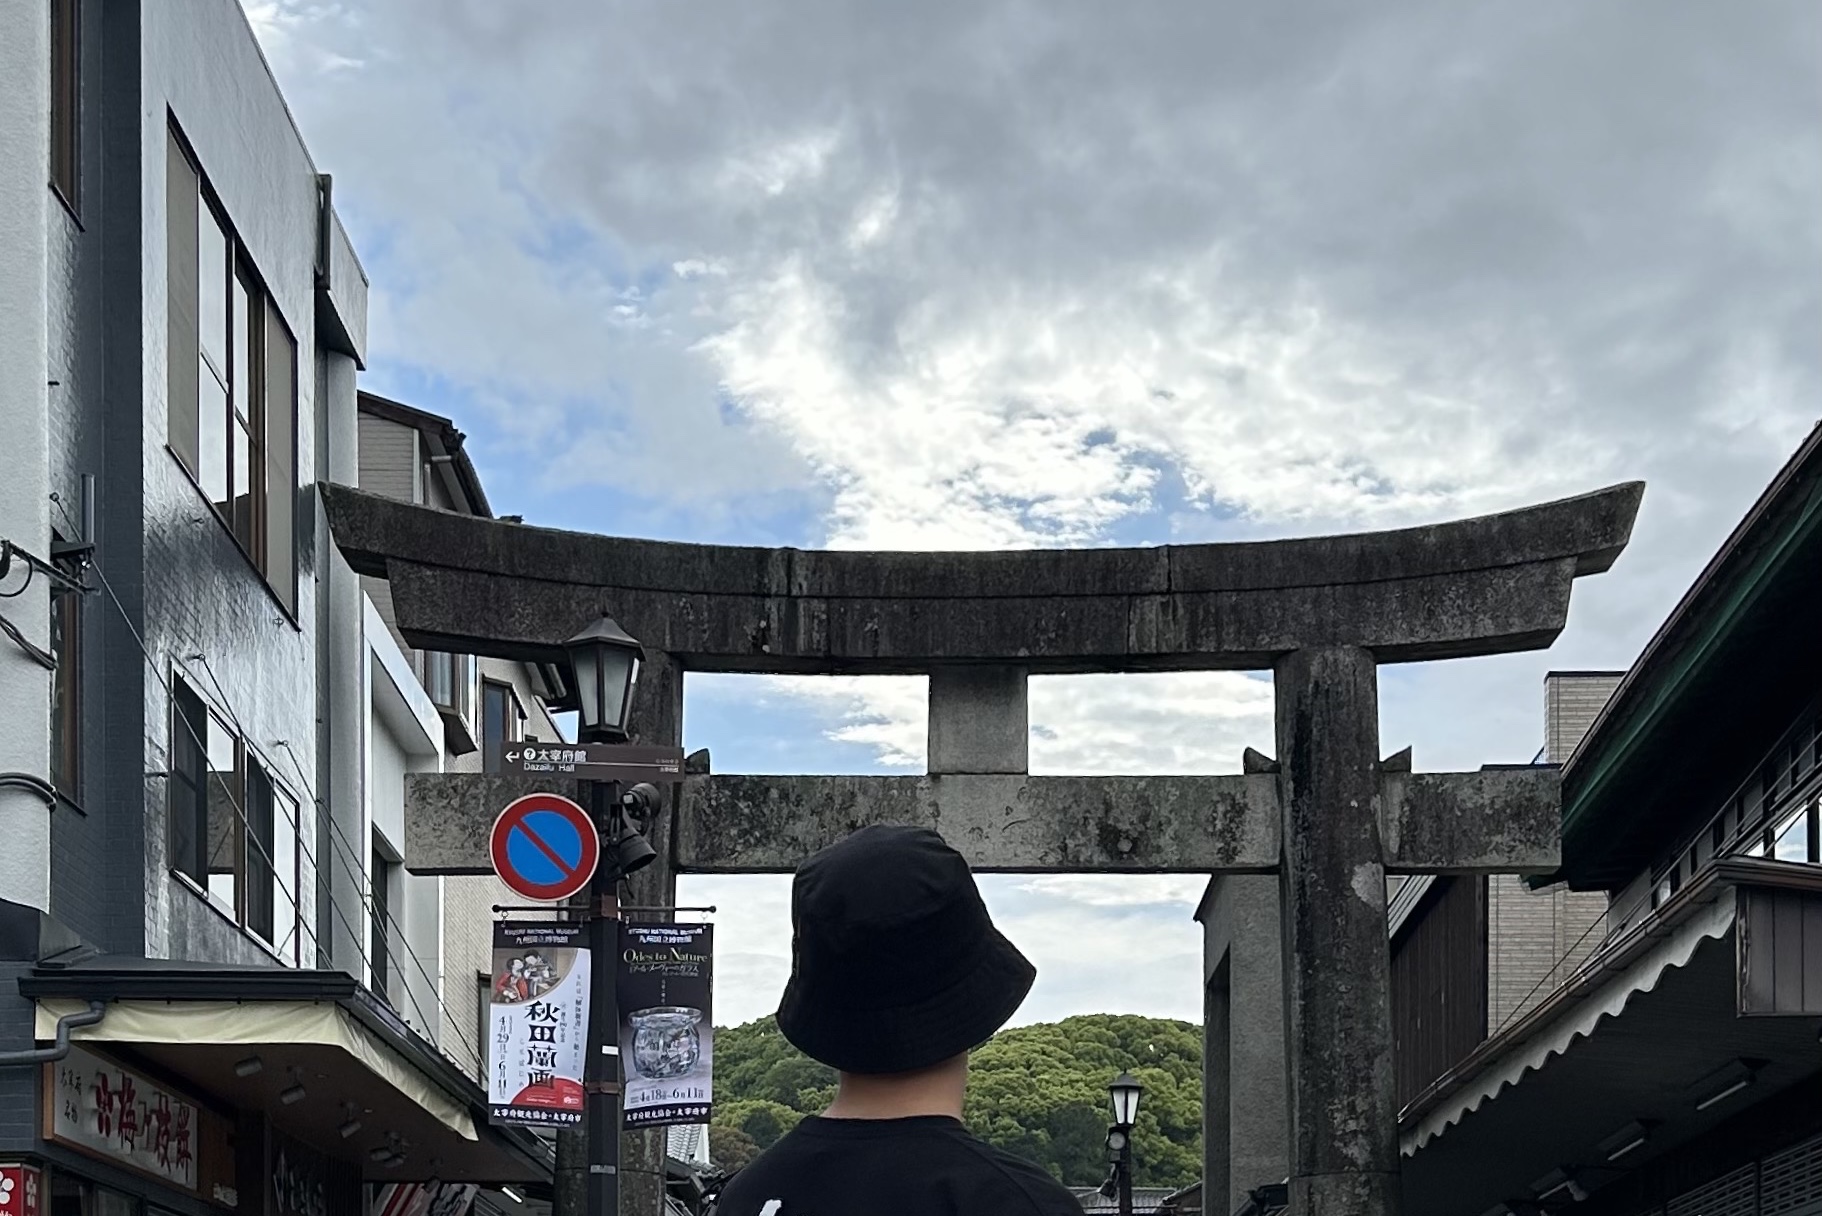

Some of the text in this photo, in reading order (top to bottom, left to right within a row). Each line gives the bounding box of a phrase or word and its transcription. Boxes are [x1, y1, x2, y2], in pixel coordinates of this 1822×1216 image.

[559, 764, 575, 772] Hall
[623, 947, 708, 963] Odes to Nature
[524, 1000, 561, 1090] 秋田蘭画
